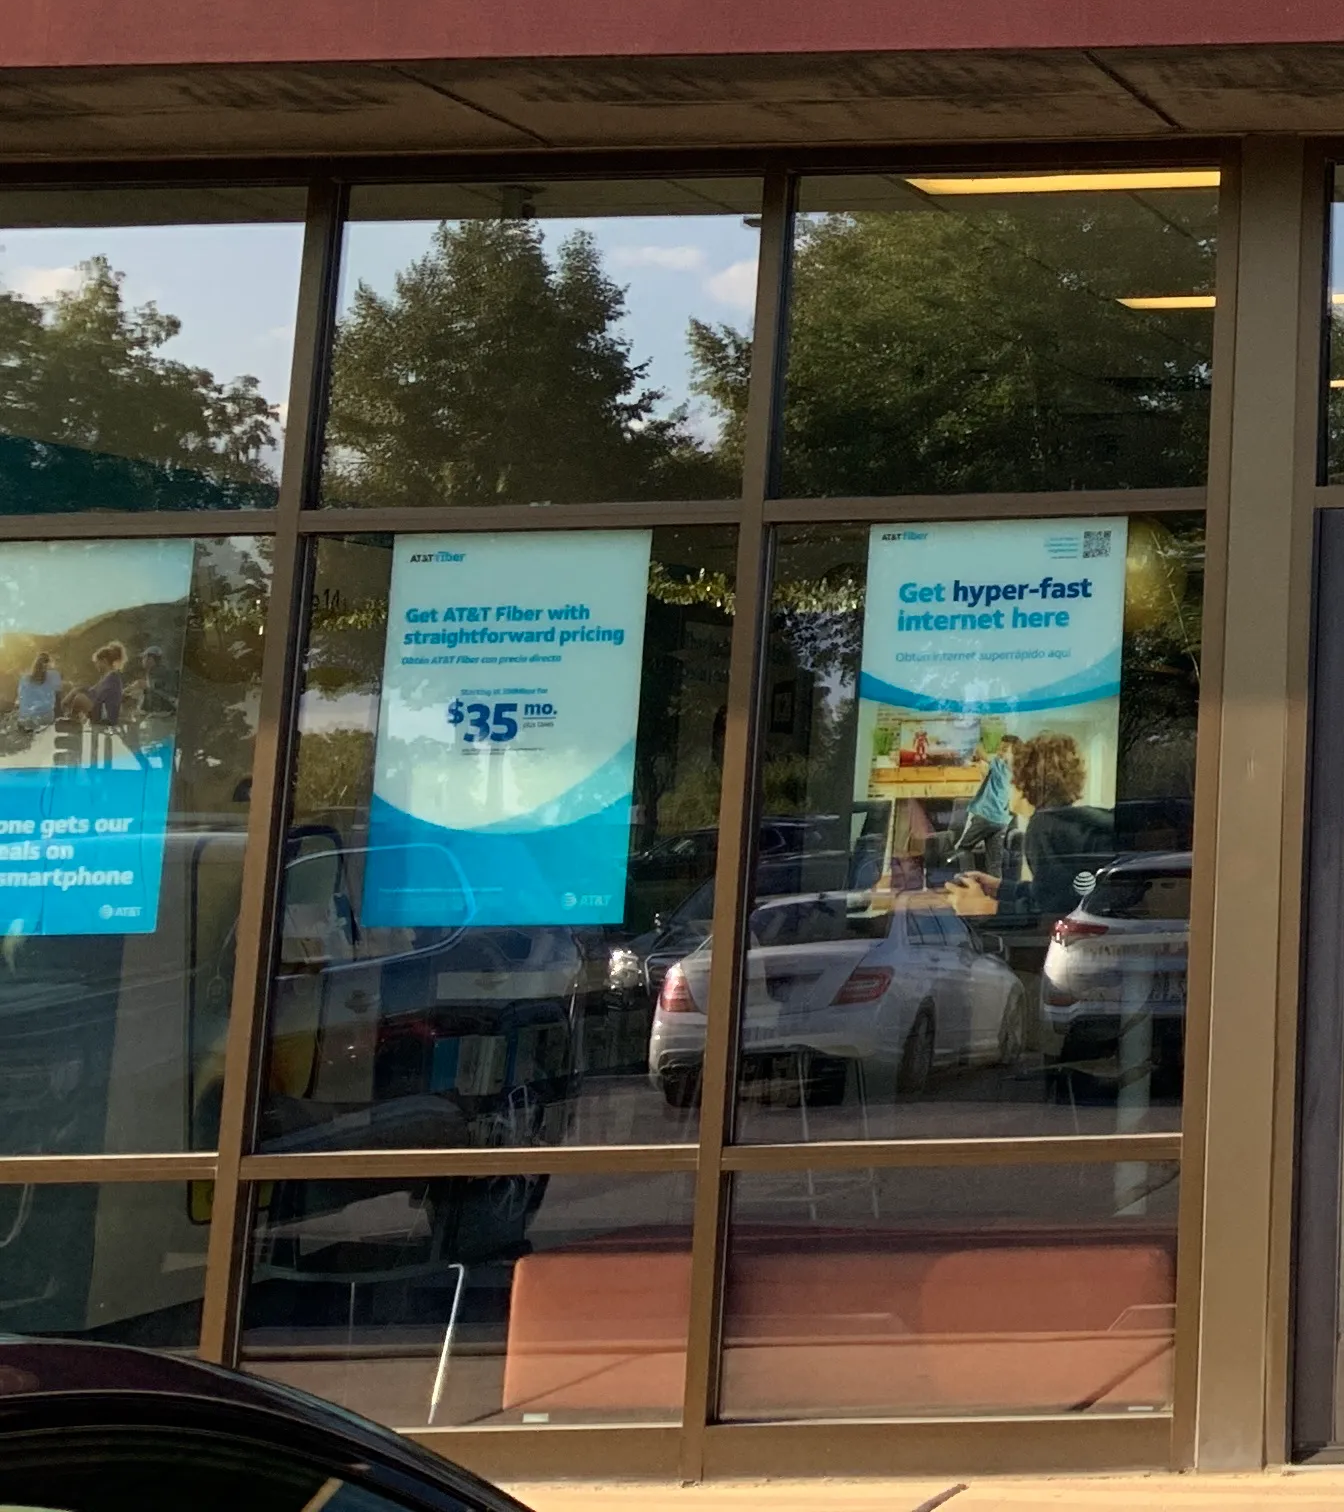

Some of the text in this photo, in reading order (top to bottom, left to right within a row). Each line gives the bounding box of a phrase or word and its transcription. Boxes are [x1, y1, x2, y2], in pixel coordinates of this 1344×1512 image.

[898, 577, 1092, 608] Get hyper-fast
[405, 604, 590, 624] Get AT&T Fiber with
[897, 606, 1070, 631] internet here
[403, 625, 625, 648] straightforward pricing
[448, 698, 558, 743] $35 mo.
[41, 816, 90, 839] gets
[95, 817, 134, 833] our
[46, 844, 74, 859] on
[579, 894, 612, 906] AT&T
